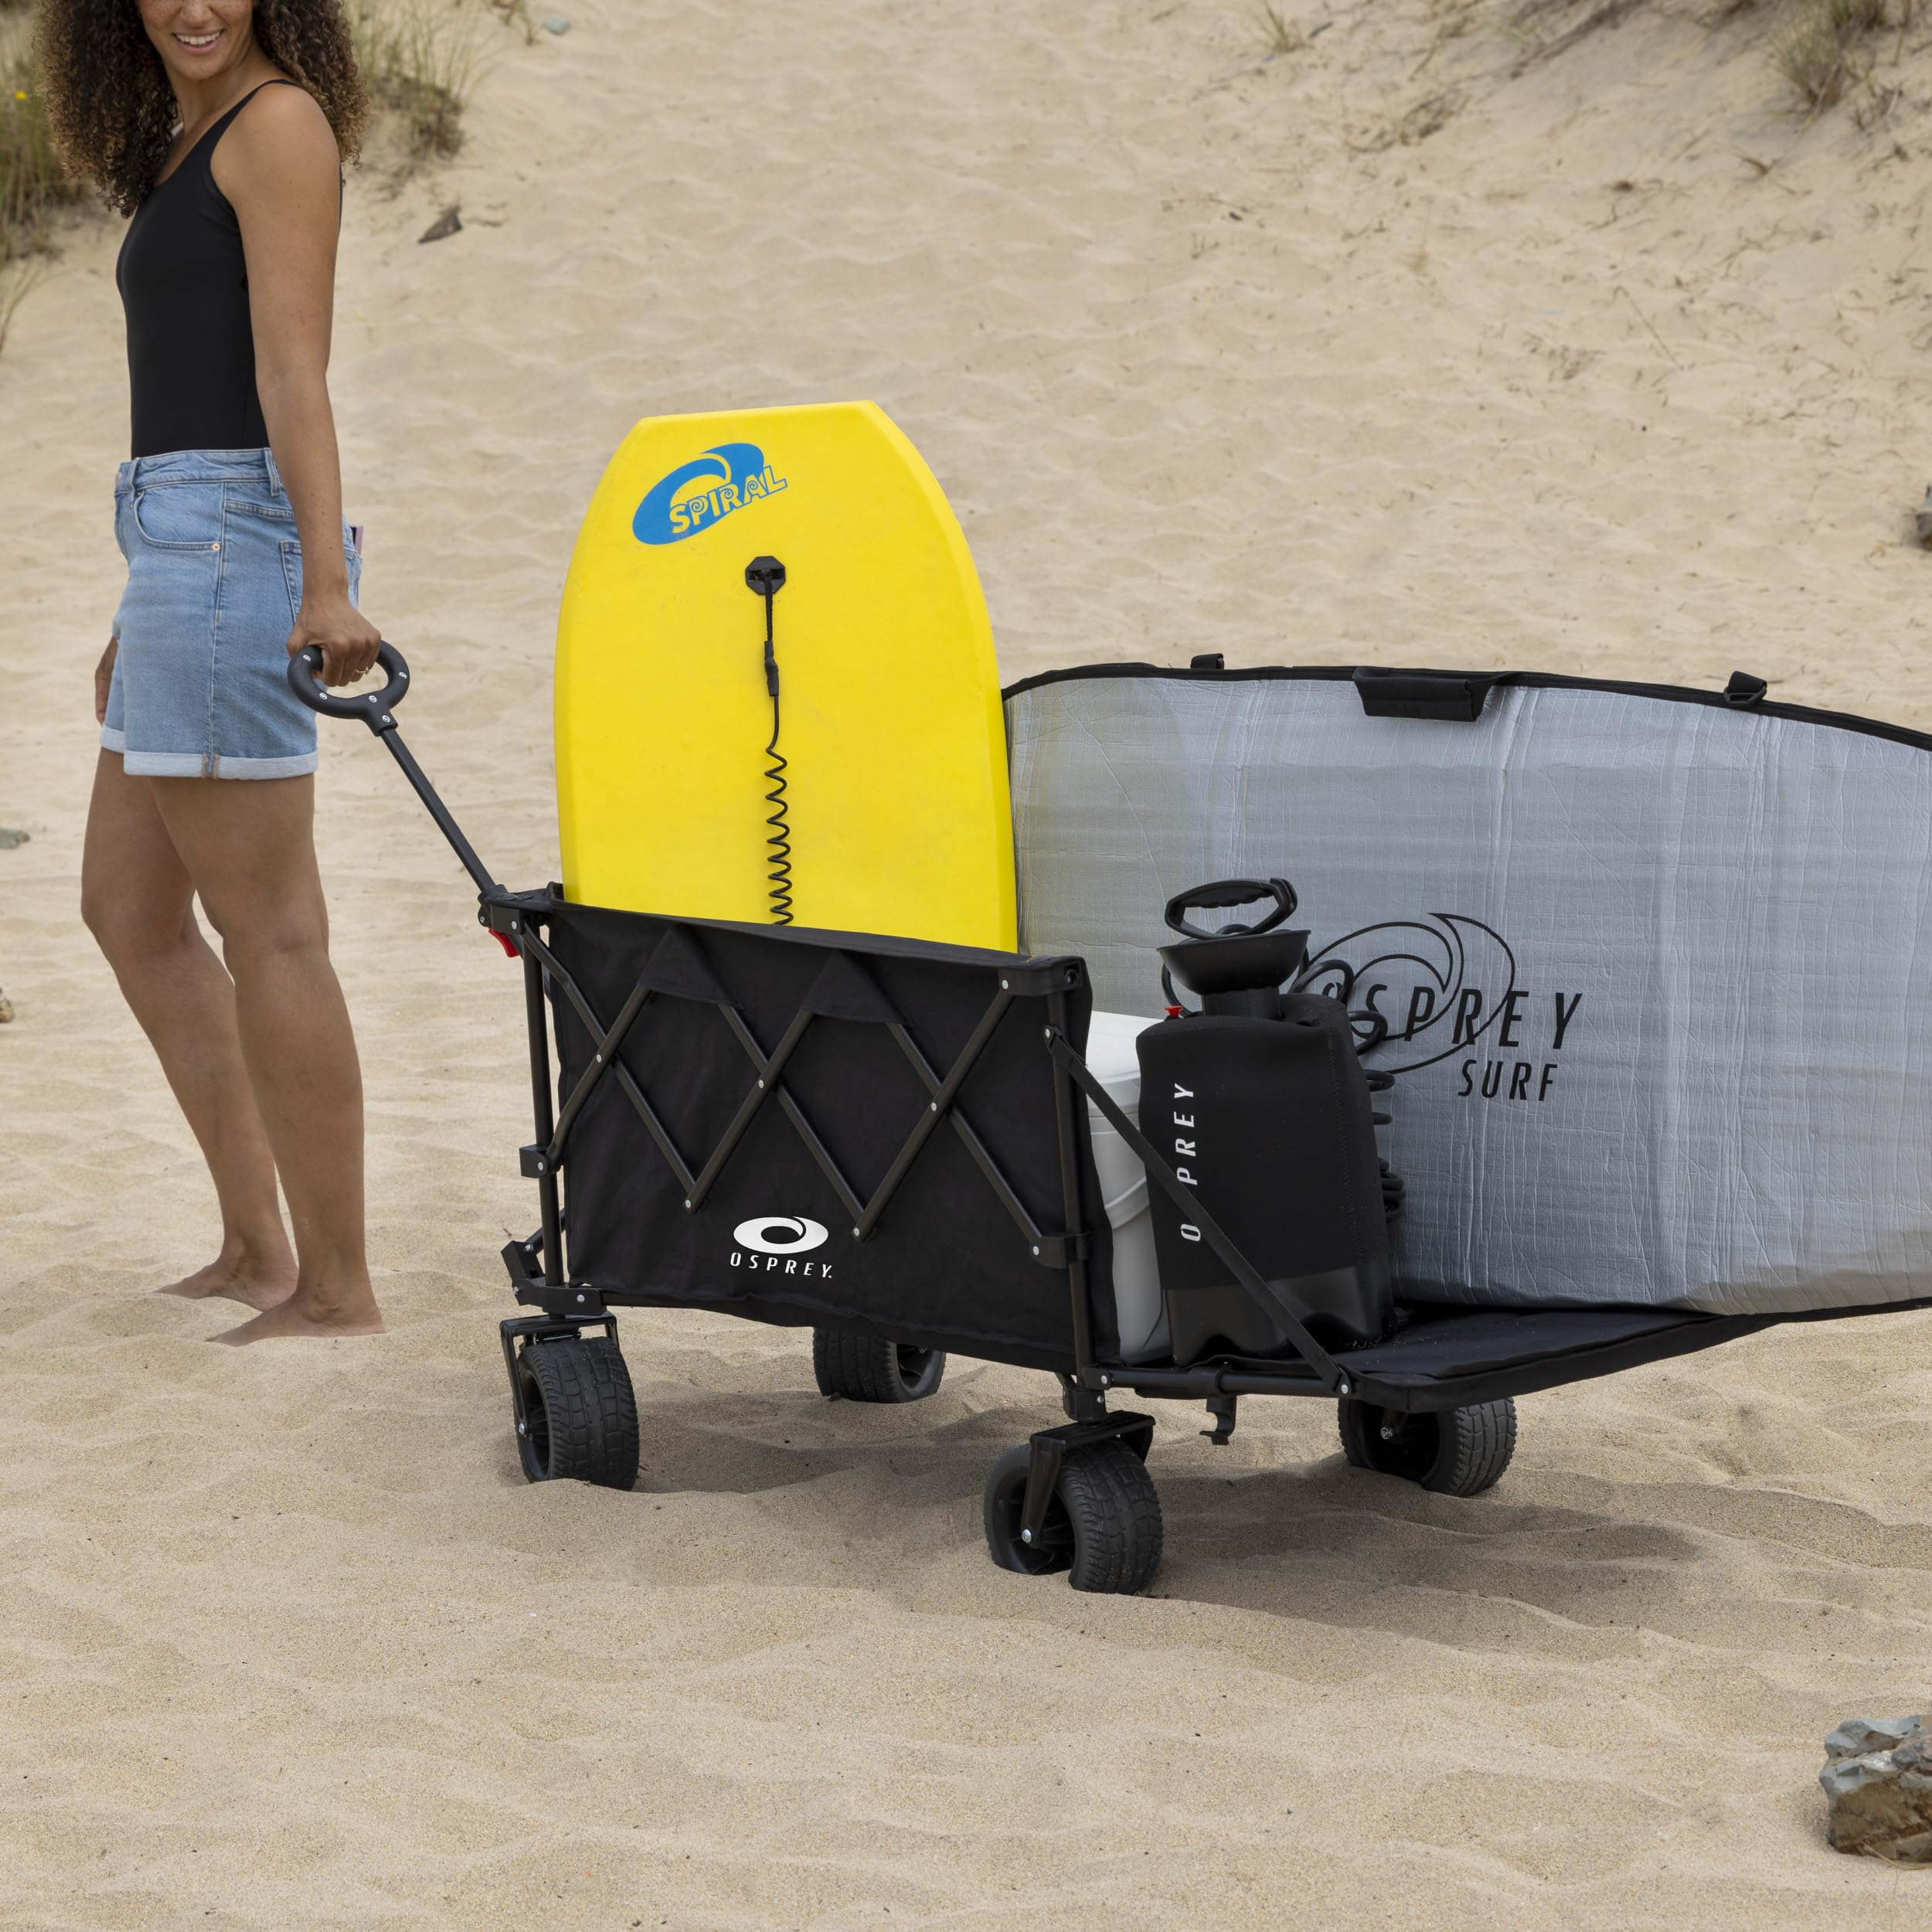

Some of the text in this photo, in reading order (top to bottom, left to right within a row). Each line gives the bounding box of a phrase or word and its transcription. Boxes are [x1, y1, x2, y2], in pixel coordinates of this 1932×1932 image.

[669, 464, 787, 534] SPIRAL
[1321, 982, 1583, 1050] SPREY
[1458, 1059, 1558, 1102] SURF
[1173, 1083, 1201, 1242] OPREY
